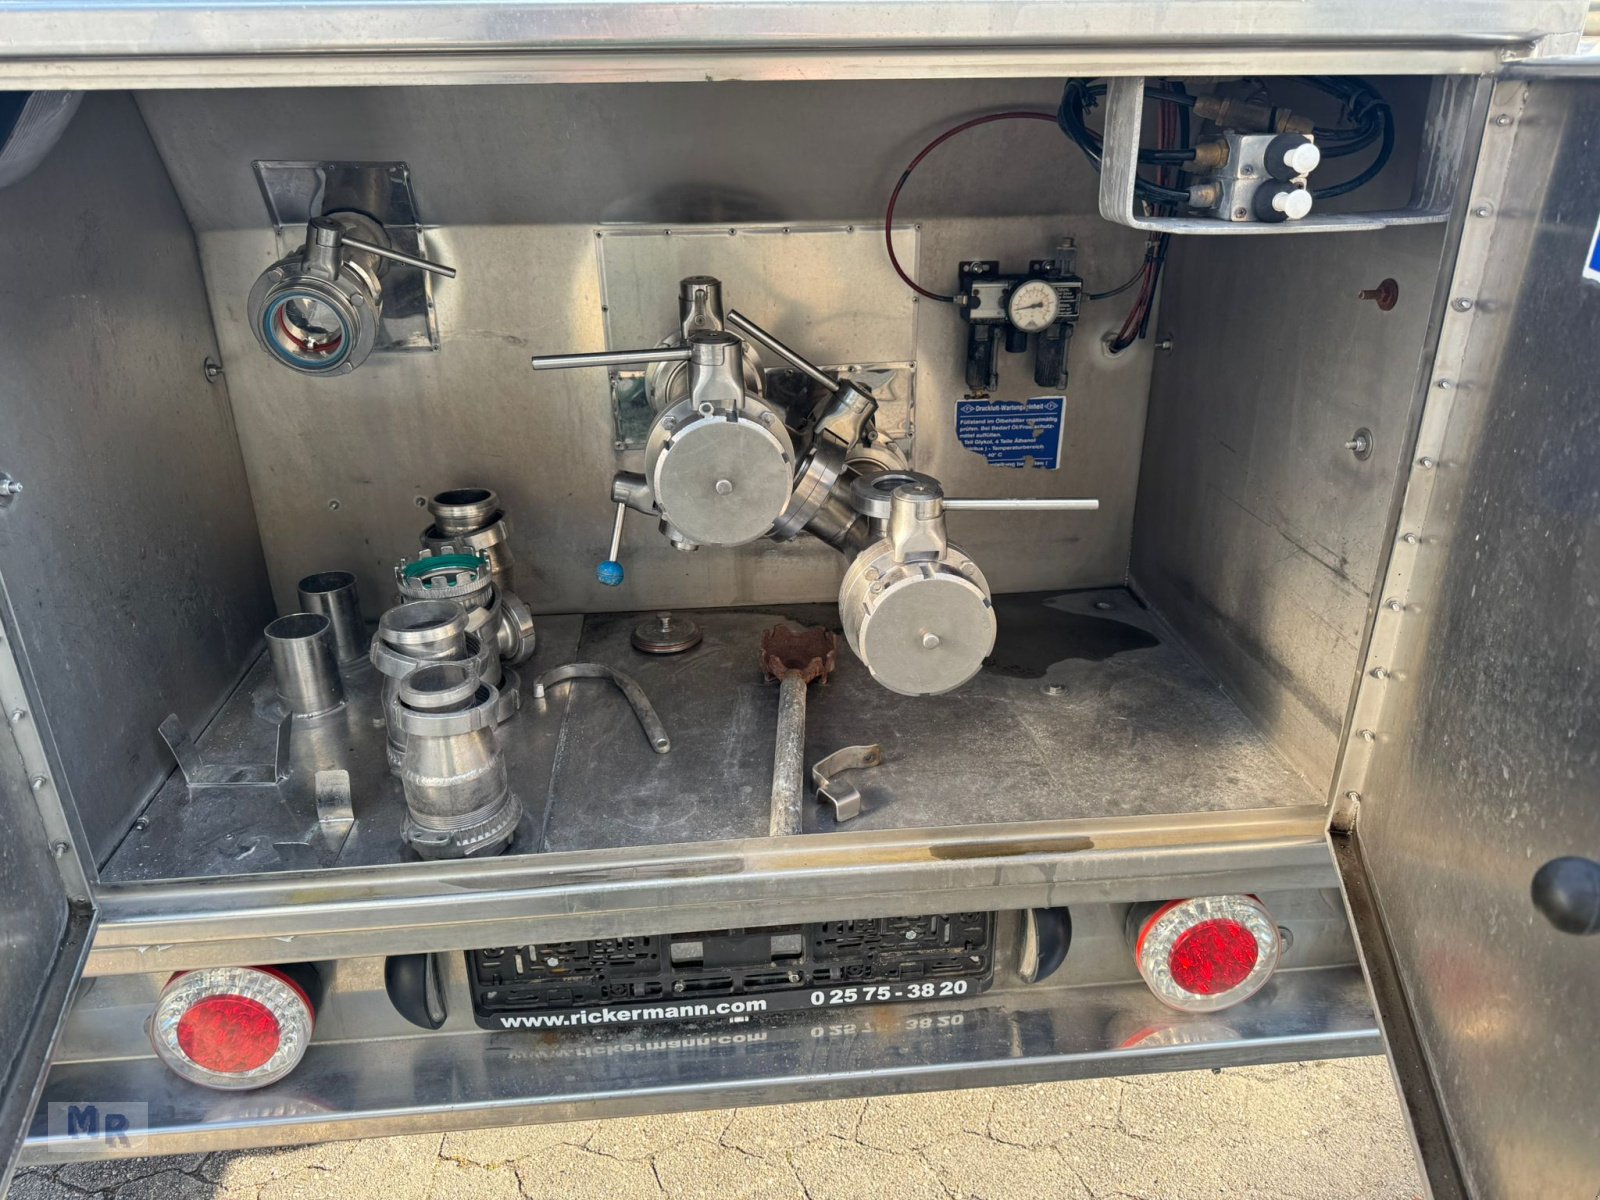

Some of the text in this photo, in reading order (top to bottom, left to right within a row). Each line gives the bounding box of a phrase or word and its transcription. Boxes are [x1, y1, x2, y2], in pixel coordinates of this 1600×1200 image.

[810, 991, 825, 1005] 0
[829, 988, 858, 1004] 25
[863, 986, 891, 1001] 75
[907, 983, 935, 999] 38
[939, 980, 967, 996] 20
[500, 999, 767, 1028] www.rickermann.com
